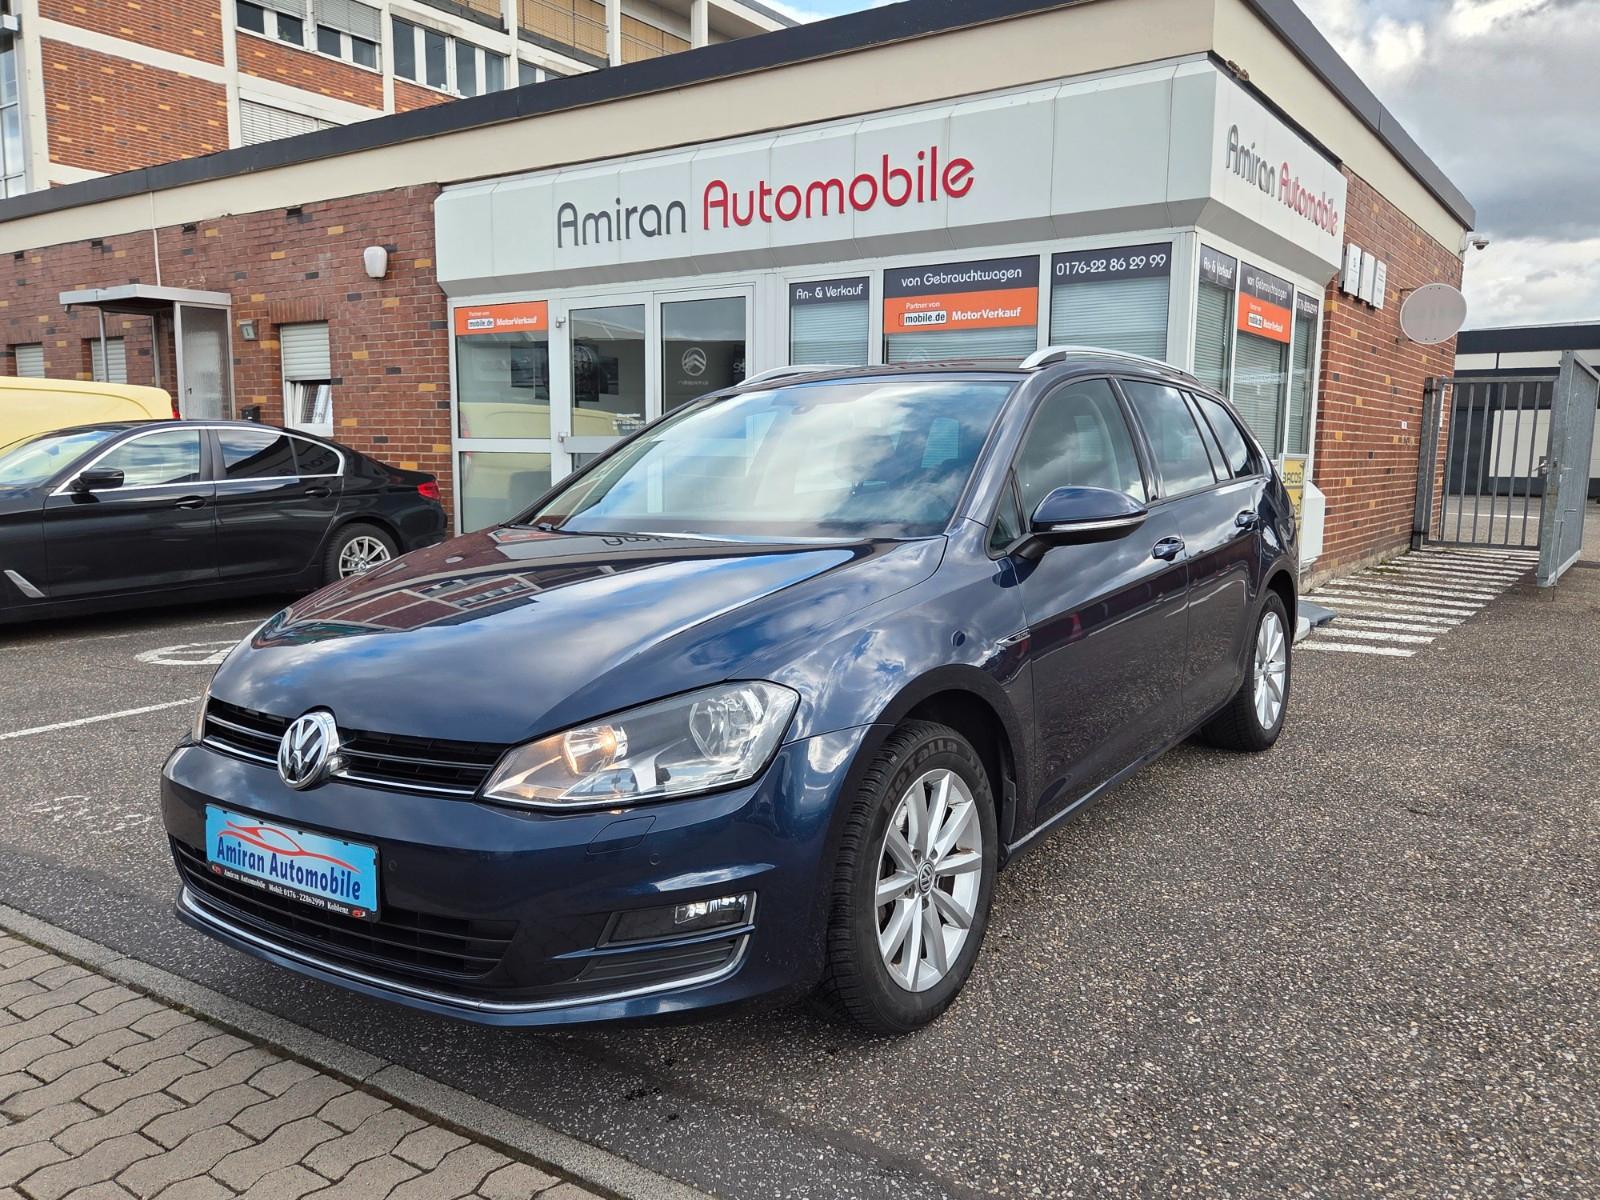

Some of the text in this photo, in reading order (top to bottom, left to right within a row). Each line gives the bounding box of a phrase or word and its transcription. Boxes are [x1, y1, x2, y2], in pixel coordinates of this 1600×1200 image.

[1226, 124, 1338, 236] Amiran Automobile
[557, 146, 975, 248] Amiran Automobile
[1056, 253, 1167, 276] 0176-22 86 29 99
[901, 267, 1022, 287] von Gebrauchtwagen
[796, 283, 864, 300] An- & Verkauf
[905, 302, 927, 310] Partner
[905, 307, 1022, 323] mobile.de MotorVerkauf
[217, 837, 361, 900] Amiran Automobile
